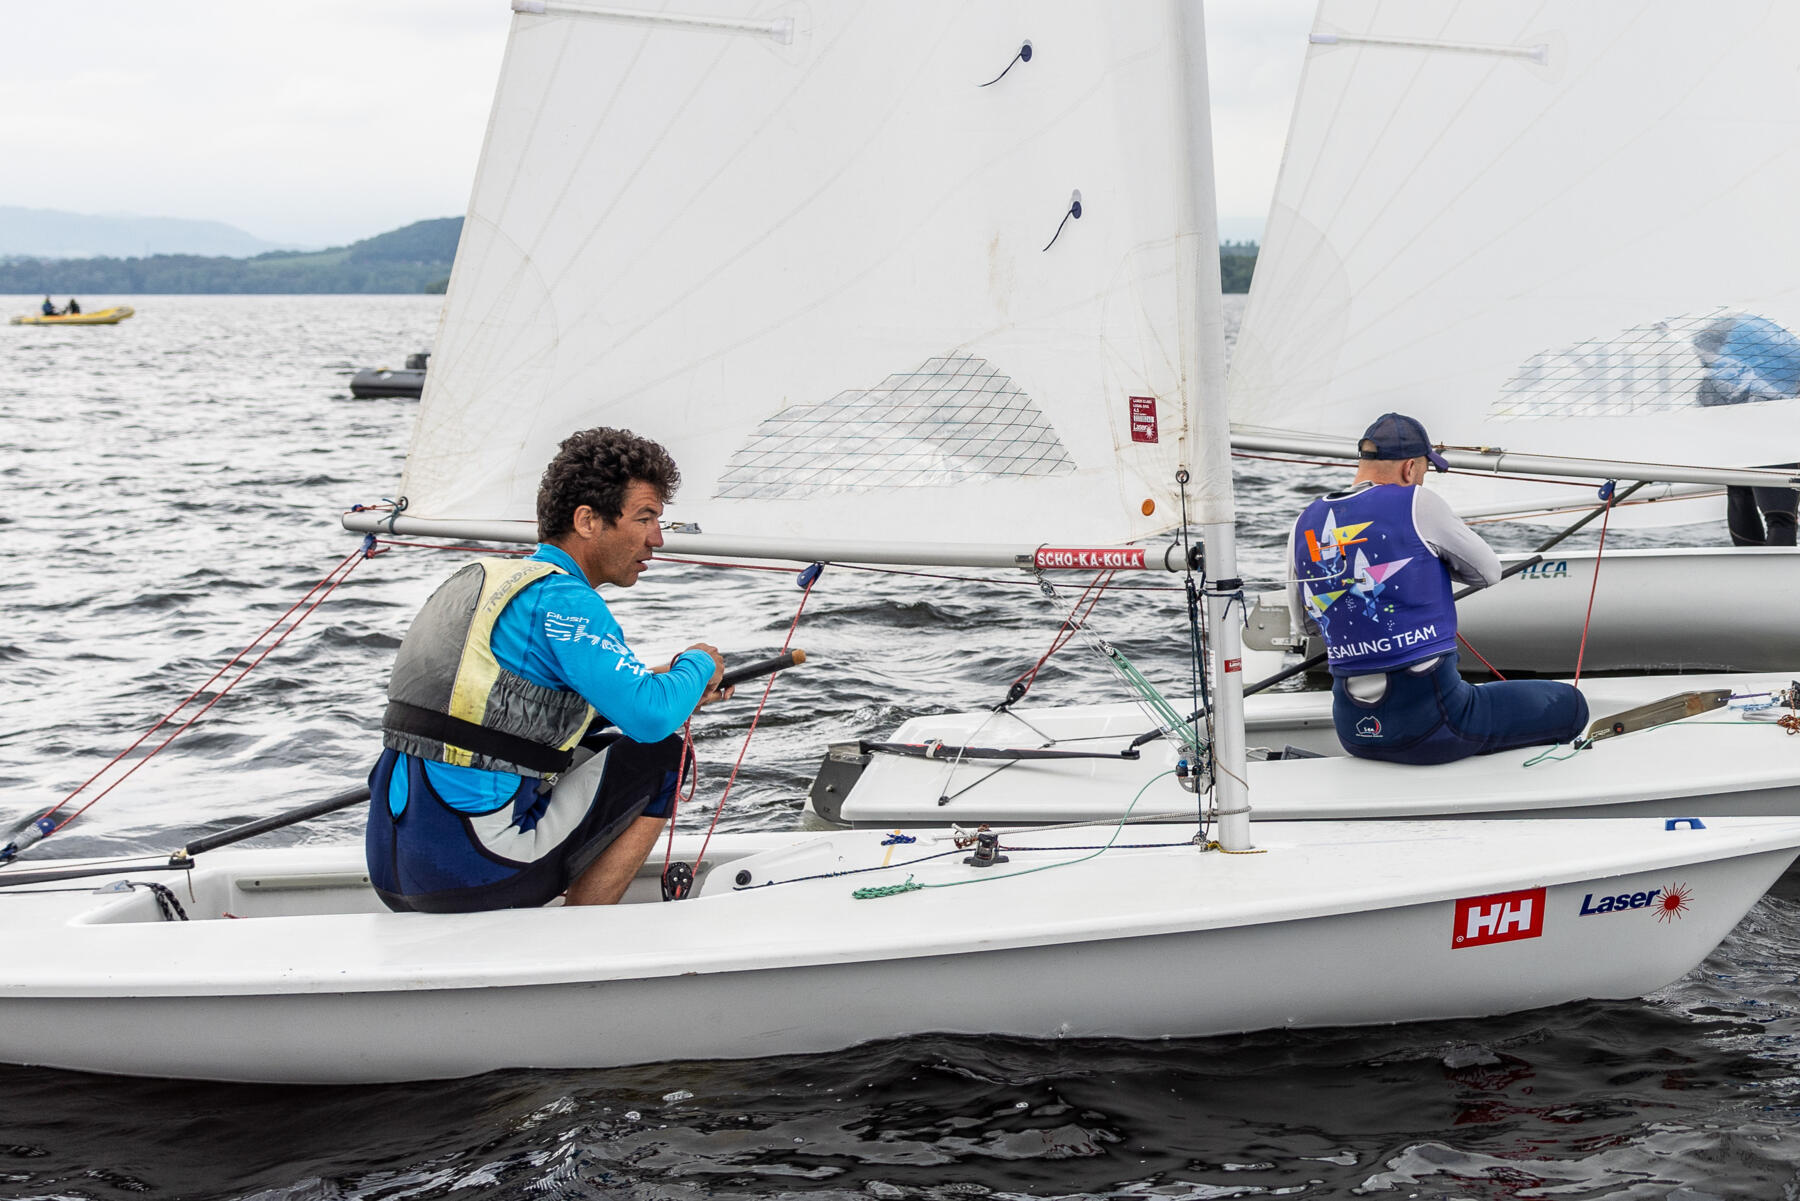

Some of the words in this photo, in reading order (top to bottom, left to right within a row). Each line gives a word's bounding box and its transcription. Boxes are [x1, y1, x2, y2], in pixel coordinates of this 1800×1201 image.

[1037, 552, 1140, 566] SCHO-KA-KOLA
[1392, 624, 1437, 648] TEAM
[1579, 889, 1661, 916] Laser
[1466, 898, 1533, 939] HH
